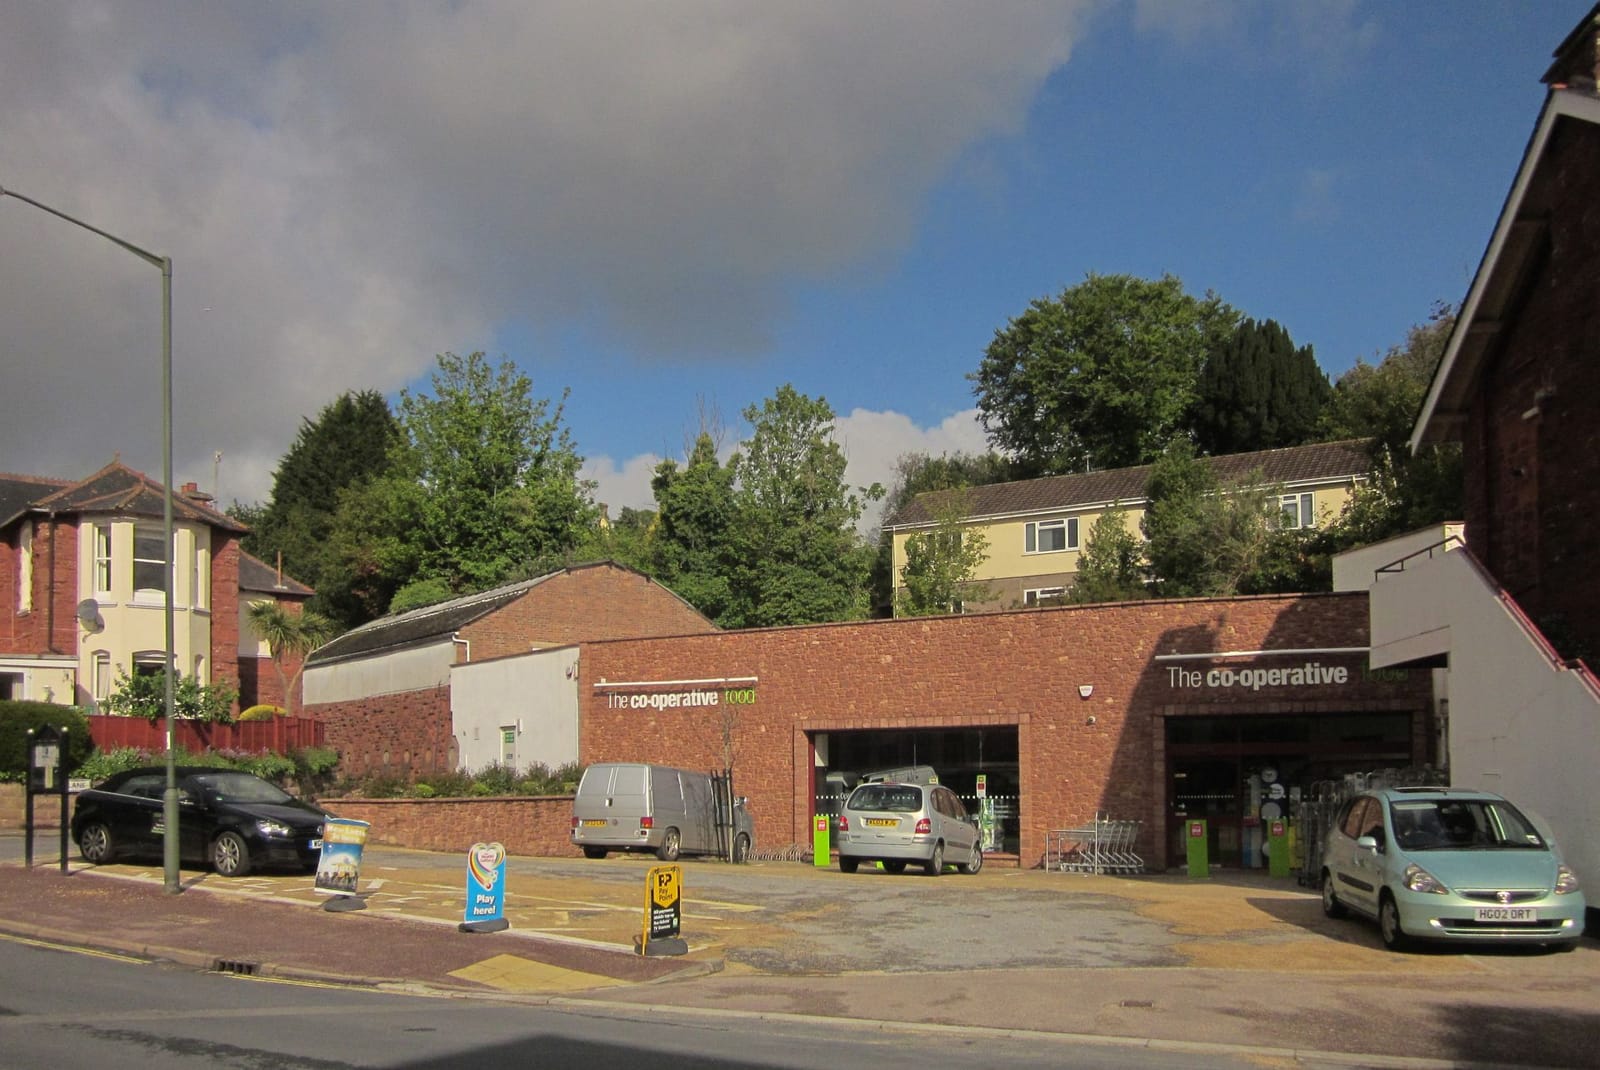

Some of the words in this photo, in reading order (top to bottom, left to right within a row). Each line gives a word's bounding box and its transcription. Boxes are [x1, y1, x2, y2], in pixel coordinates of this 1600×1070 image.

[1166, 666, 1202, 688] The
[1206, 662, 1348, 691] co-operative
[607, 692, 628, 708] The
[631, 689, 718, 711] co-operative
[476, 894, 495, 904] Play
[473, 905, 496, 915] here!
[1480, 909, 1509, 920] HG02
